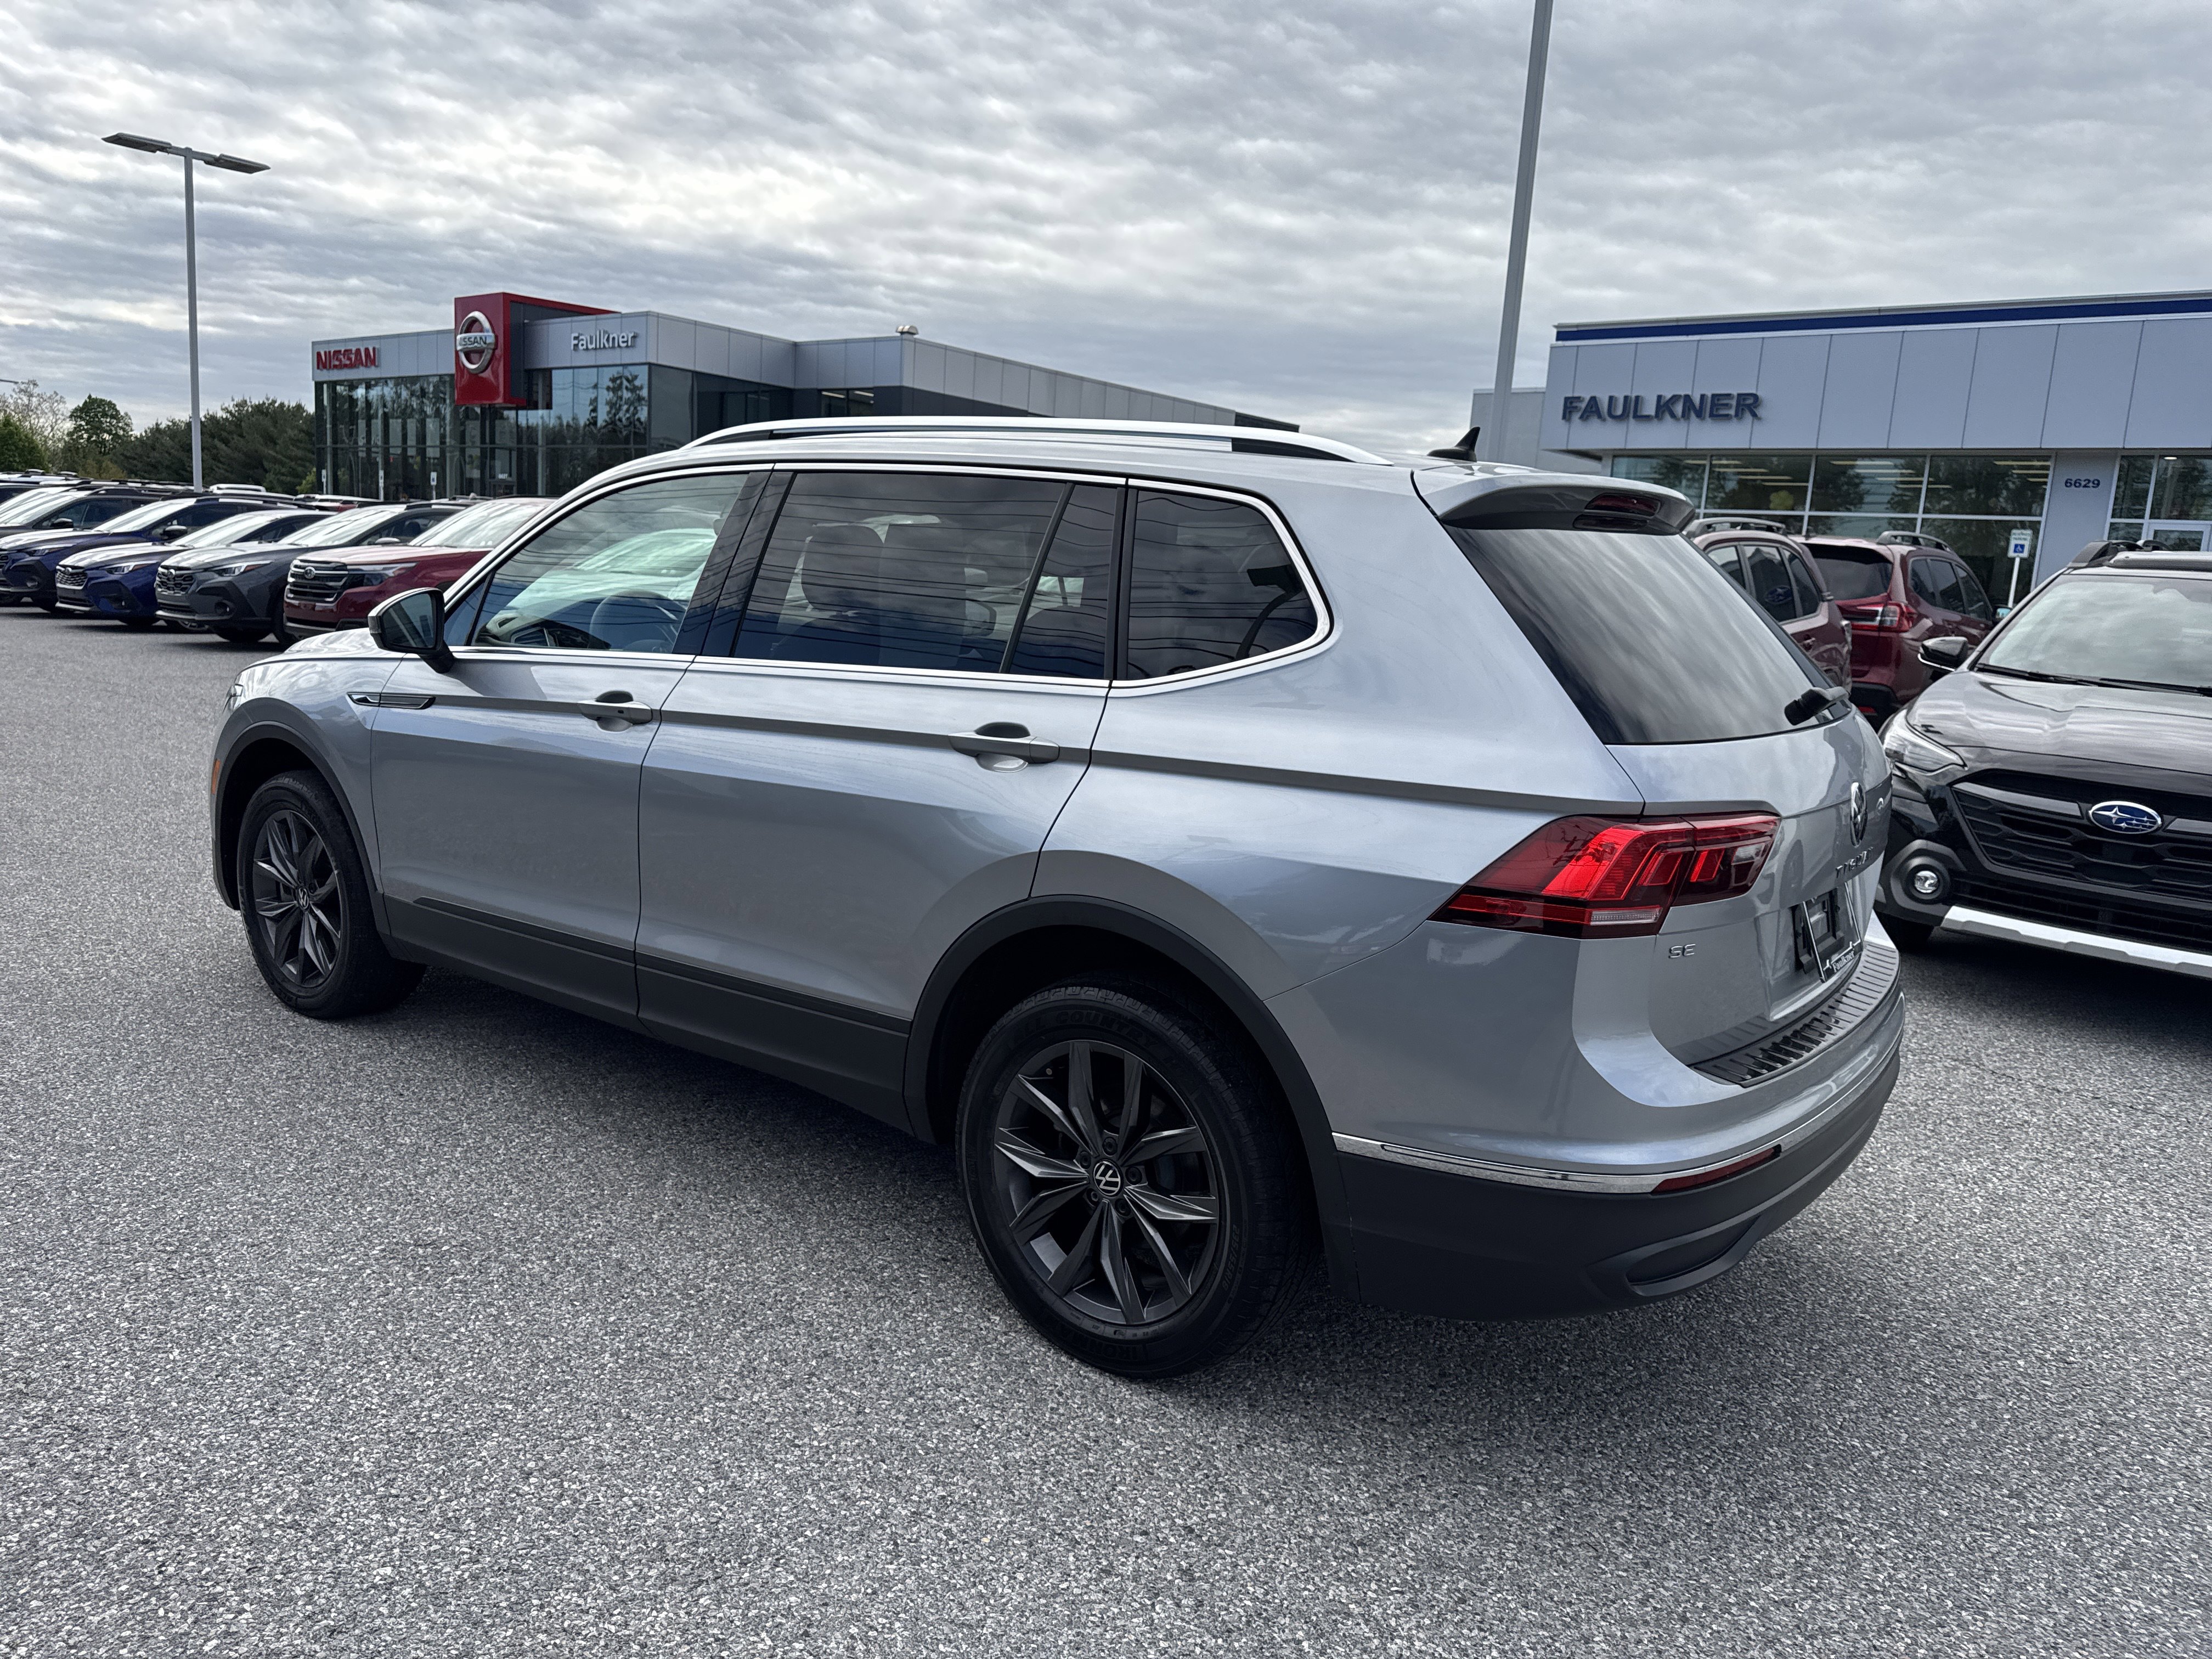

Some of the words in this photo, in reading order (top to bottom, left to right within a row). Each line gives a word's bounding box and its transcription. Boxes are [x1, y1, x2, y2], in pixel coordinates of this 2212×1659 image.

[571, 330, 635, 350] Faulkner
[317, 347, 377, 370] NISSAN
[1562, 393, 1761, 421] FAULKNER
[2064, 478, 2101, 488] 6629
[1668, 944, 1696, 958] SE
[1832, 951, 1854, 972] Faulkner
[1055, 1011, 1158, 1048] COUNTRY
[1222, 1224, 1240, 1291] 235/55R18
